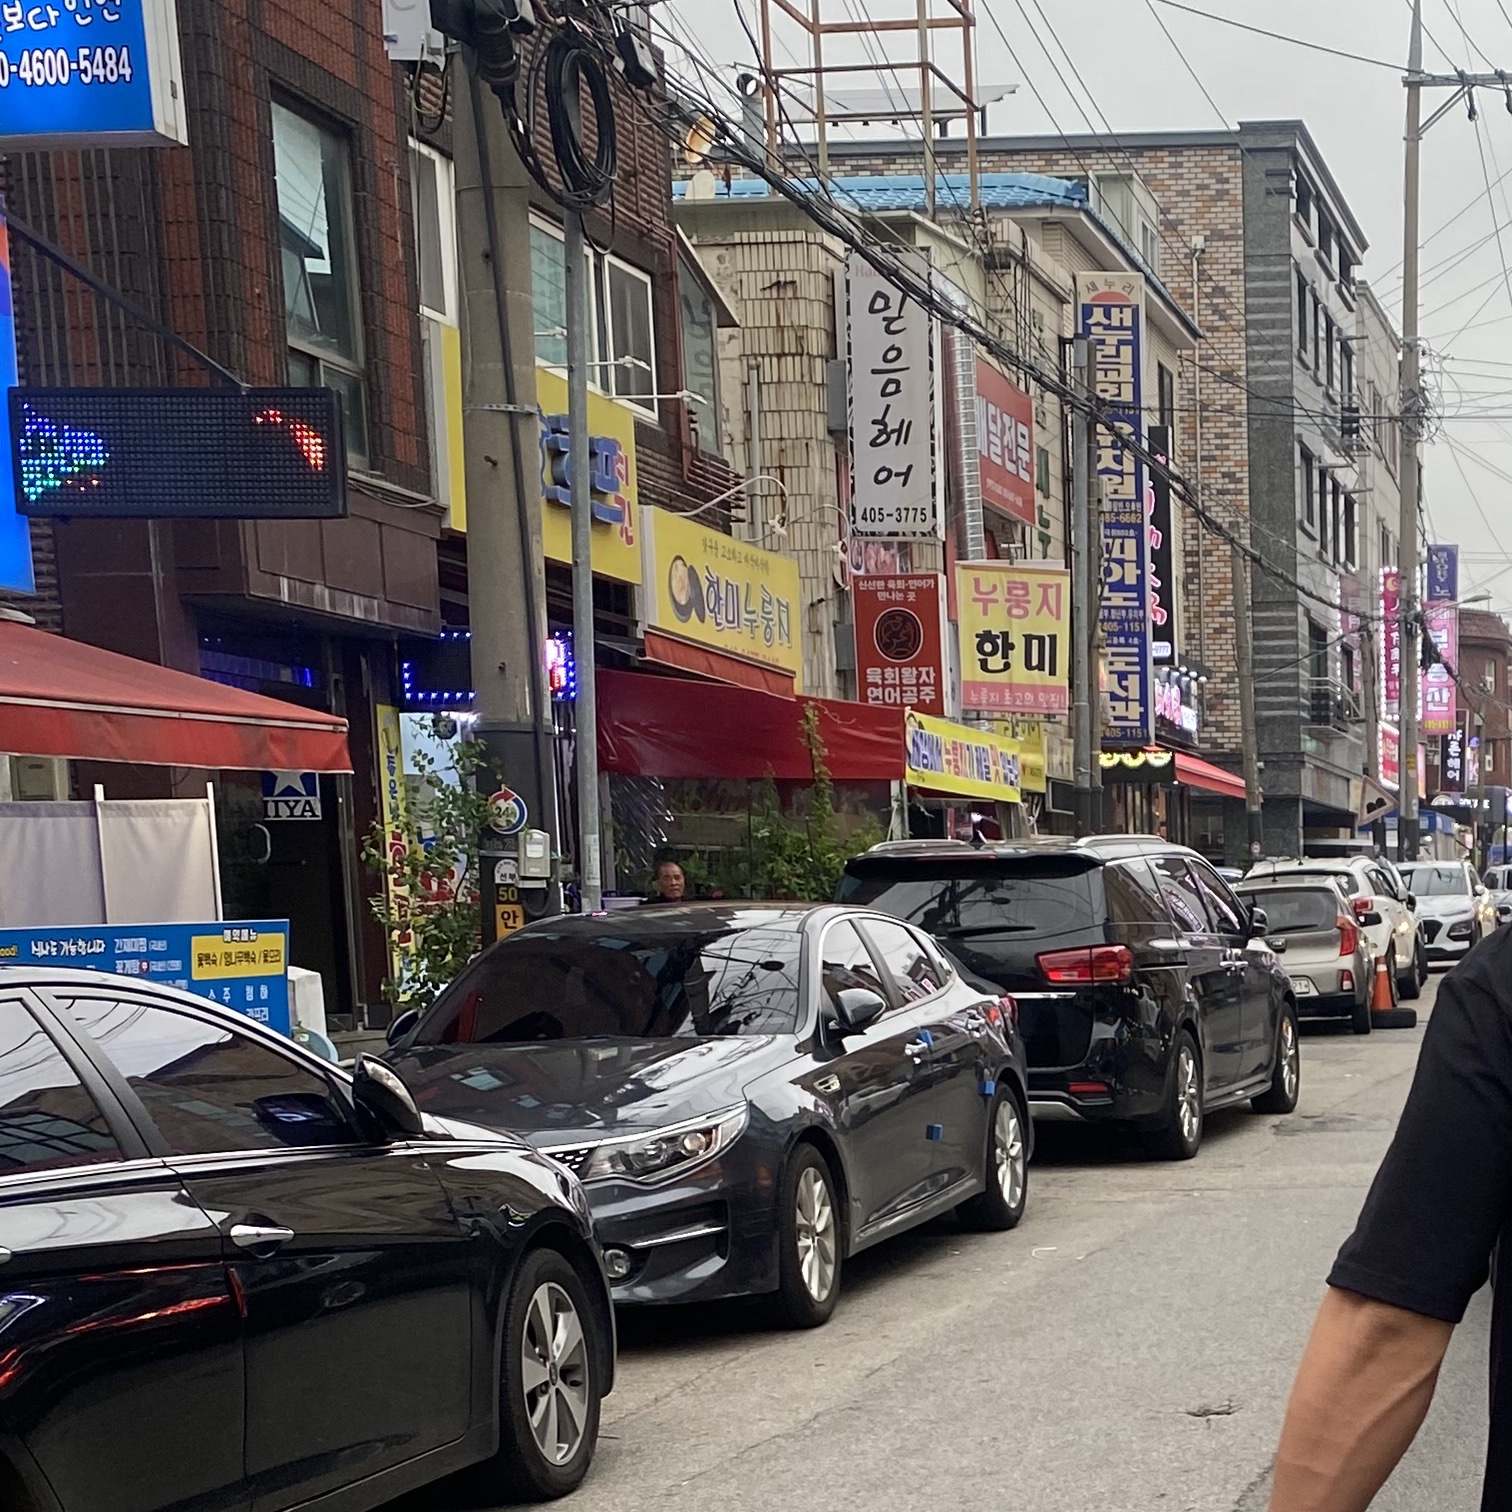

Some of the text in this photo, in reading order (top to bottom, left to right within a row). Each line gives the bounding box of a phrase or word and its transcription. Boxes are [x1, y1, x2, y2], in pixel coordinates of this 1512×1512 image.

[1085, 277, 1136, 298] 새누리
[868, 288, 914, 488] 믿음헤어
[860, 507, 928, 523] 405-3775
[971, 577, 1063, 621] 누룽지
[974, 629, 1059, 677] 한미
[866, 666, 936, 686] 육회왕자
[866, 686, 936, 705] 연어공주
[500, 910, 520, 930] 안
